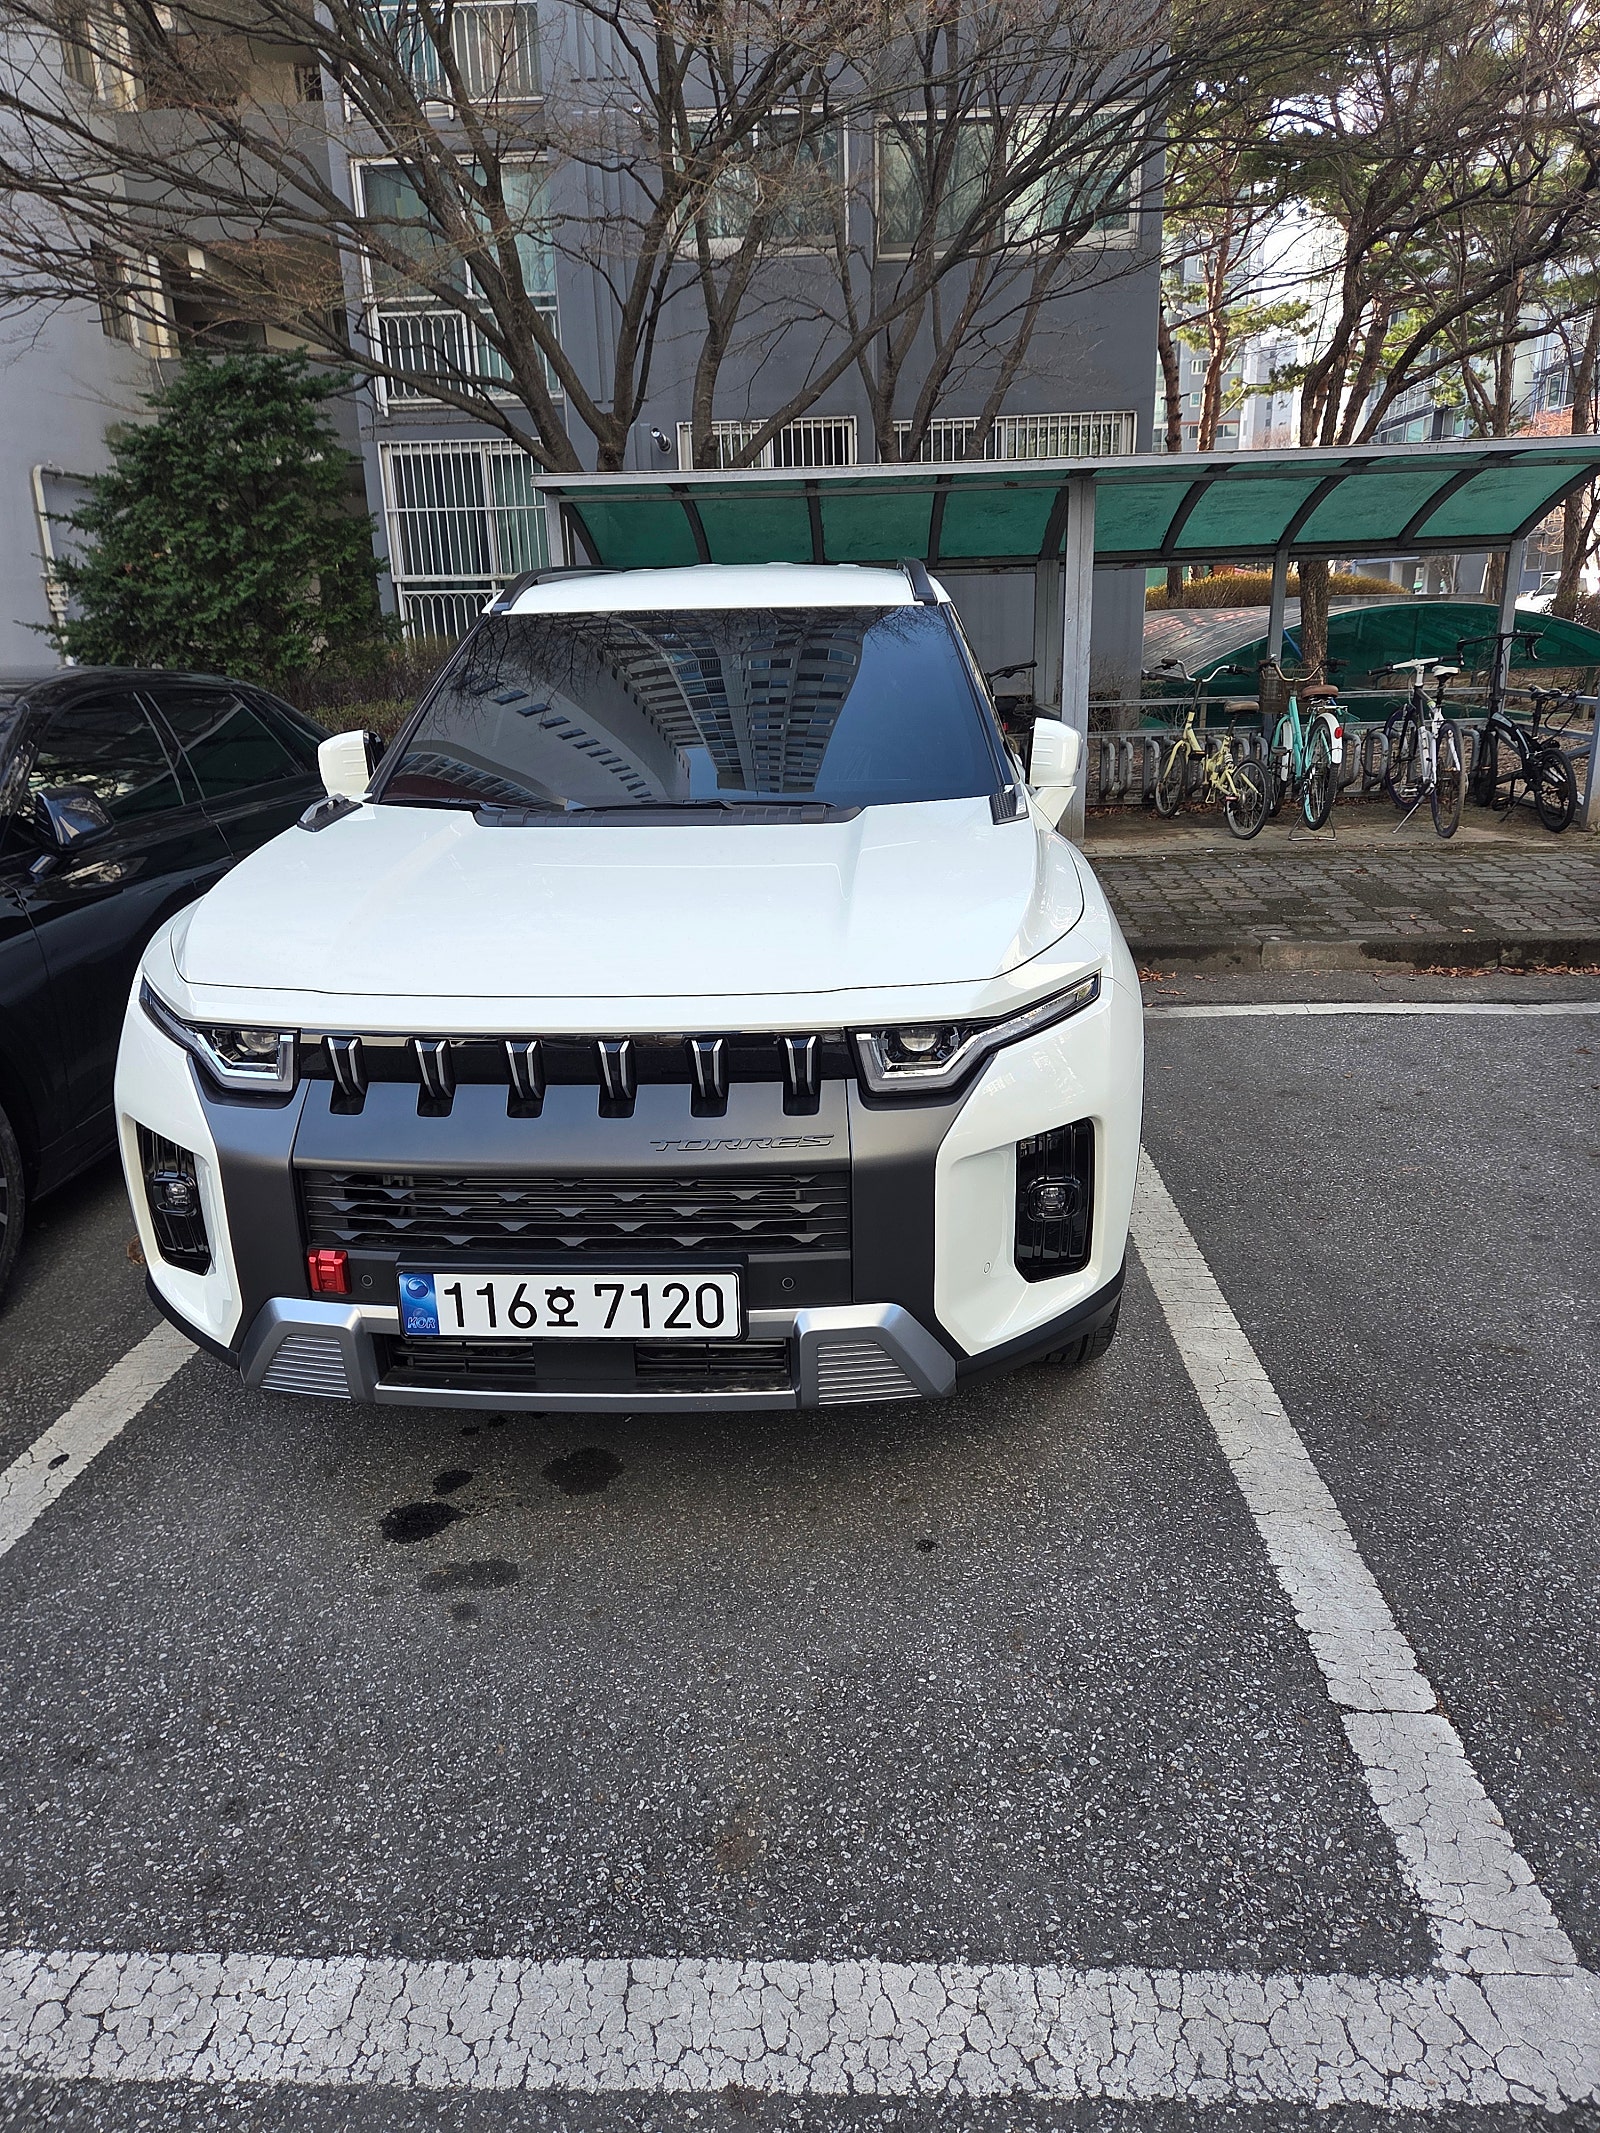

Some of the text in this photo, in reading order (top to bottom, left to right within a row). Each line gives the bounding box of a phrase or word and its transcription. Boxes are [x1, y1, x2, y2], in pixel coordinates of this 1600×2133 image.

[650, 1134, 835, 1151] TORRES
[443, 1281, 725, 1329] 116호 7120
[407, 1316, 436, 1329] KOR
